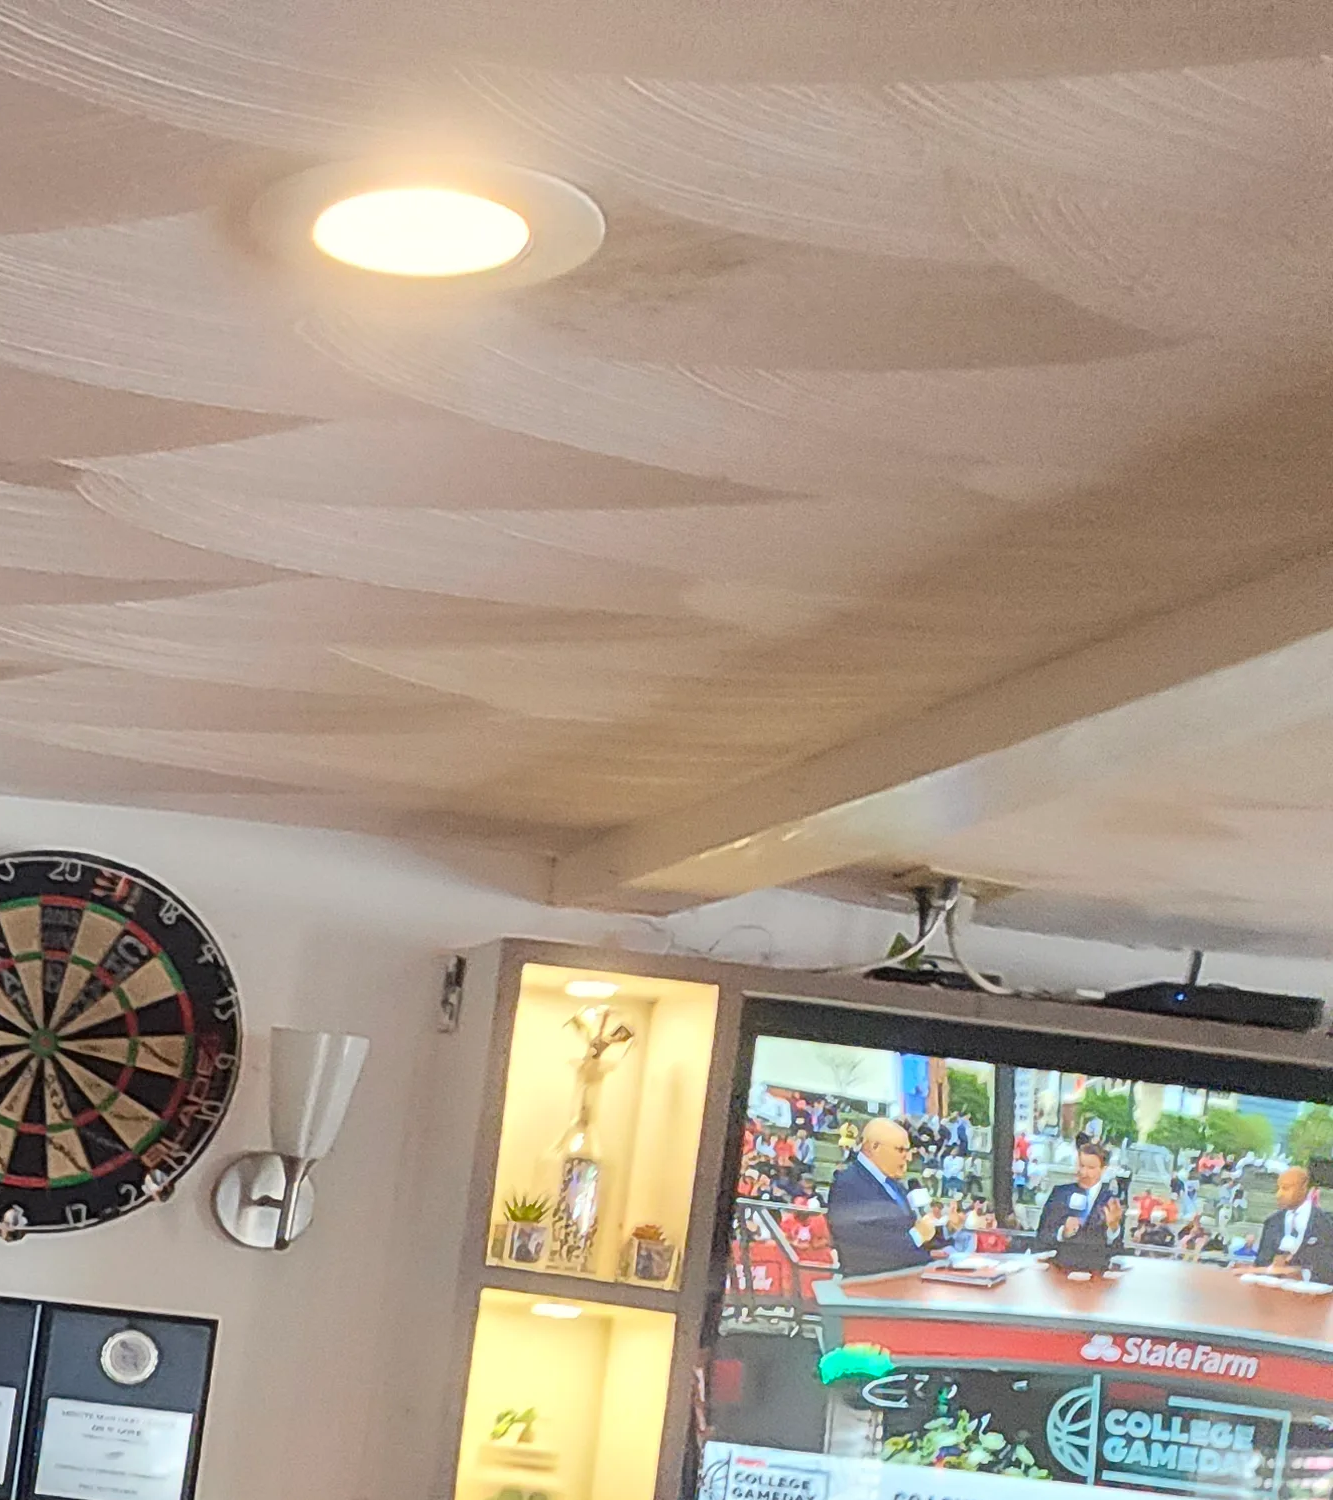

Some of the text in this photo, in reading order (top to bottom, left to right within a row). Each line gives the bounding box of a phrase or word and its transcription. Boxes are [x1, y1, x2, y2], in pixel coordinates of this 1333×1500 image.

[49, 860, 82, 882] 20
[159, 899, 183, 925] 18
[1104, 1409, 1255, 1450] COLLEGE
[1102, 1437, 1260, 1479] GAMEDAY
[734, 1470, 811, 1490] COLLEGE
